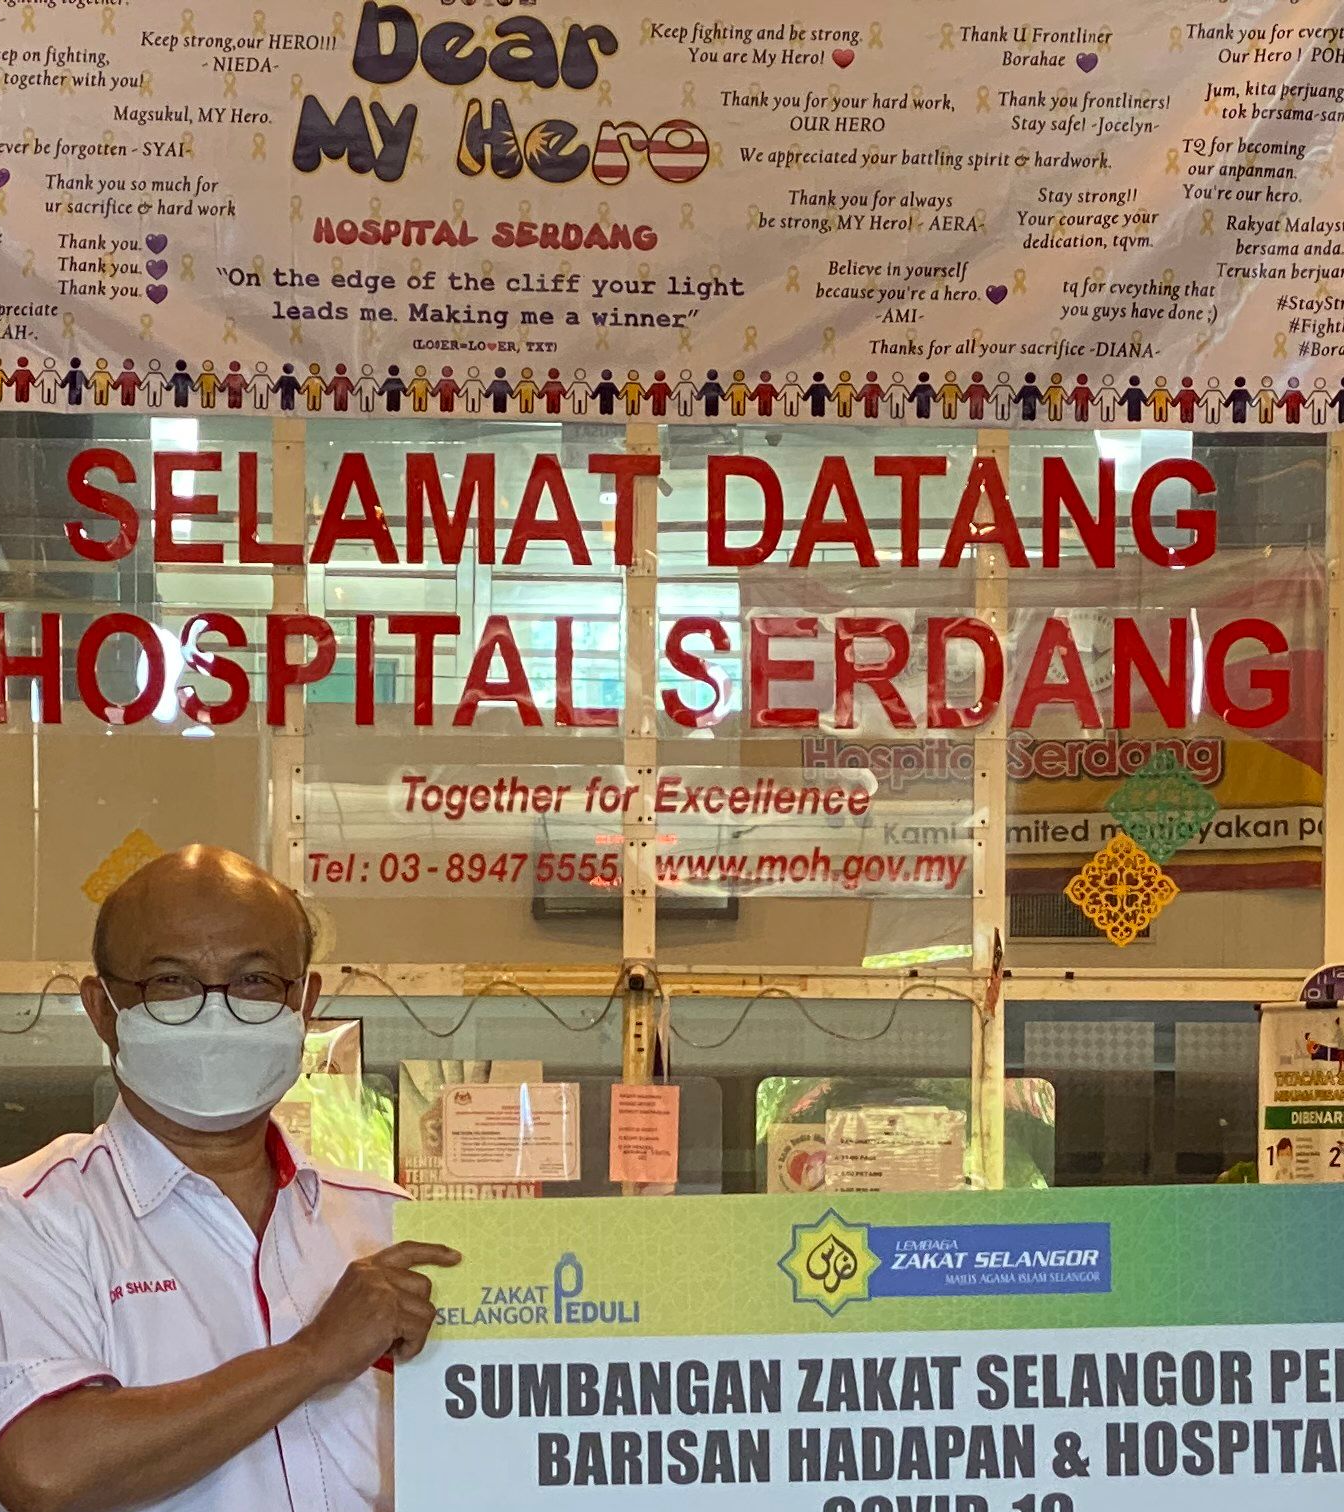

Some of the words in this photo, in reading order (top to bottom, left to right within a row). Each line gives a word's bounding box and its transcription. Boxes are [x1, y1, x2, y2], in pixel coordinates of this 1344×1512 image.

[354, 0, 619, 91] Dear
[1002, 50, 1066, 67] Borahae
[198, 107, 227, 123] MY
[230, 108, 274, 124] Hero.
[1222, 103, 1247, 119] tok
[455, 97, 712, 188] Hero
[739, 147, 764, 163] We
[767, 148, 858, 169] appreciated
[861, 153, 898, 168] your
[901, 148, 964, 171] battling
[967, 153, 1010, 172] spirit
[1014, 154, 1030, 167] &
[1034, 150, 1110, 169] hardwork.
[312, 217, 478, 248] HOSPITAL
[491, 221, 658, 251] SERDANG
[1226, 214, 1281, 236] Rakyat
[272, 267, 320, 288] the
[331, 269, 396, 294] edge
[406, 271, 437, 290] of
[447, 272, 496, 292] the
[506, 273, 581, 293] cliff
[591, 279, 657, 298] your
[666, 275, 745, 301] light
[271, 300, 349, 321] leads
[359, 307, 400, 322] me.
[408, 303, 509, 330] Making
[520, 310, 555, 325] me
[565, 311, 581, 326] a
[64, 447, 661, 567] SELAMAT
[706, 454, 1219, 571] DATANG
[661, 614, 1293, 731] SERDANG
[802, 734, 975, 791] Hospita
[400, 775, 571, 820] Together
[584, 776, 638, 815] for
[653, 776, 872, 816] Excellence
[656, 849, 967, 889] www.moh.gov.my
[1329, 1146, 1341, 1168] 2
[891, 1252, 969, 1270] ZAKAT
[974, 1249, 1099, 1268] SELANGOR
[895, 1239, 959, 1251] LEMBAGA
[481, 1285, 549, 1305] ZAKAT
[434, 1306, 549, 1327] SELANGOR
[444, 1359, 782, 1419] SUMBANGAN
[797, 1356, 962, 1413] ZAKAT
[976, 1350, 1253, 1411] SELANGOR
[538, 1429, 770, 1486] BARISAN
[788, 1424, 1036, 1483] HADAPAN
[1052, 1431, 1090, 1479] &
